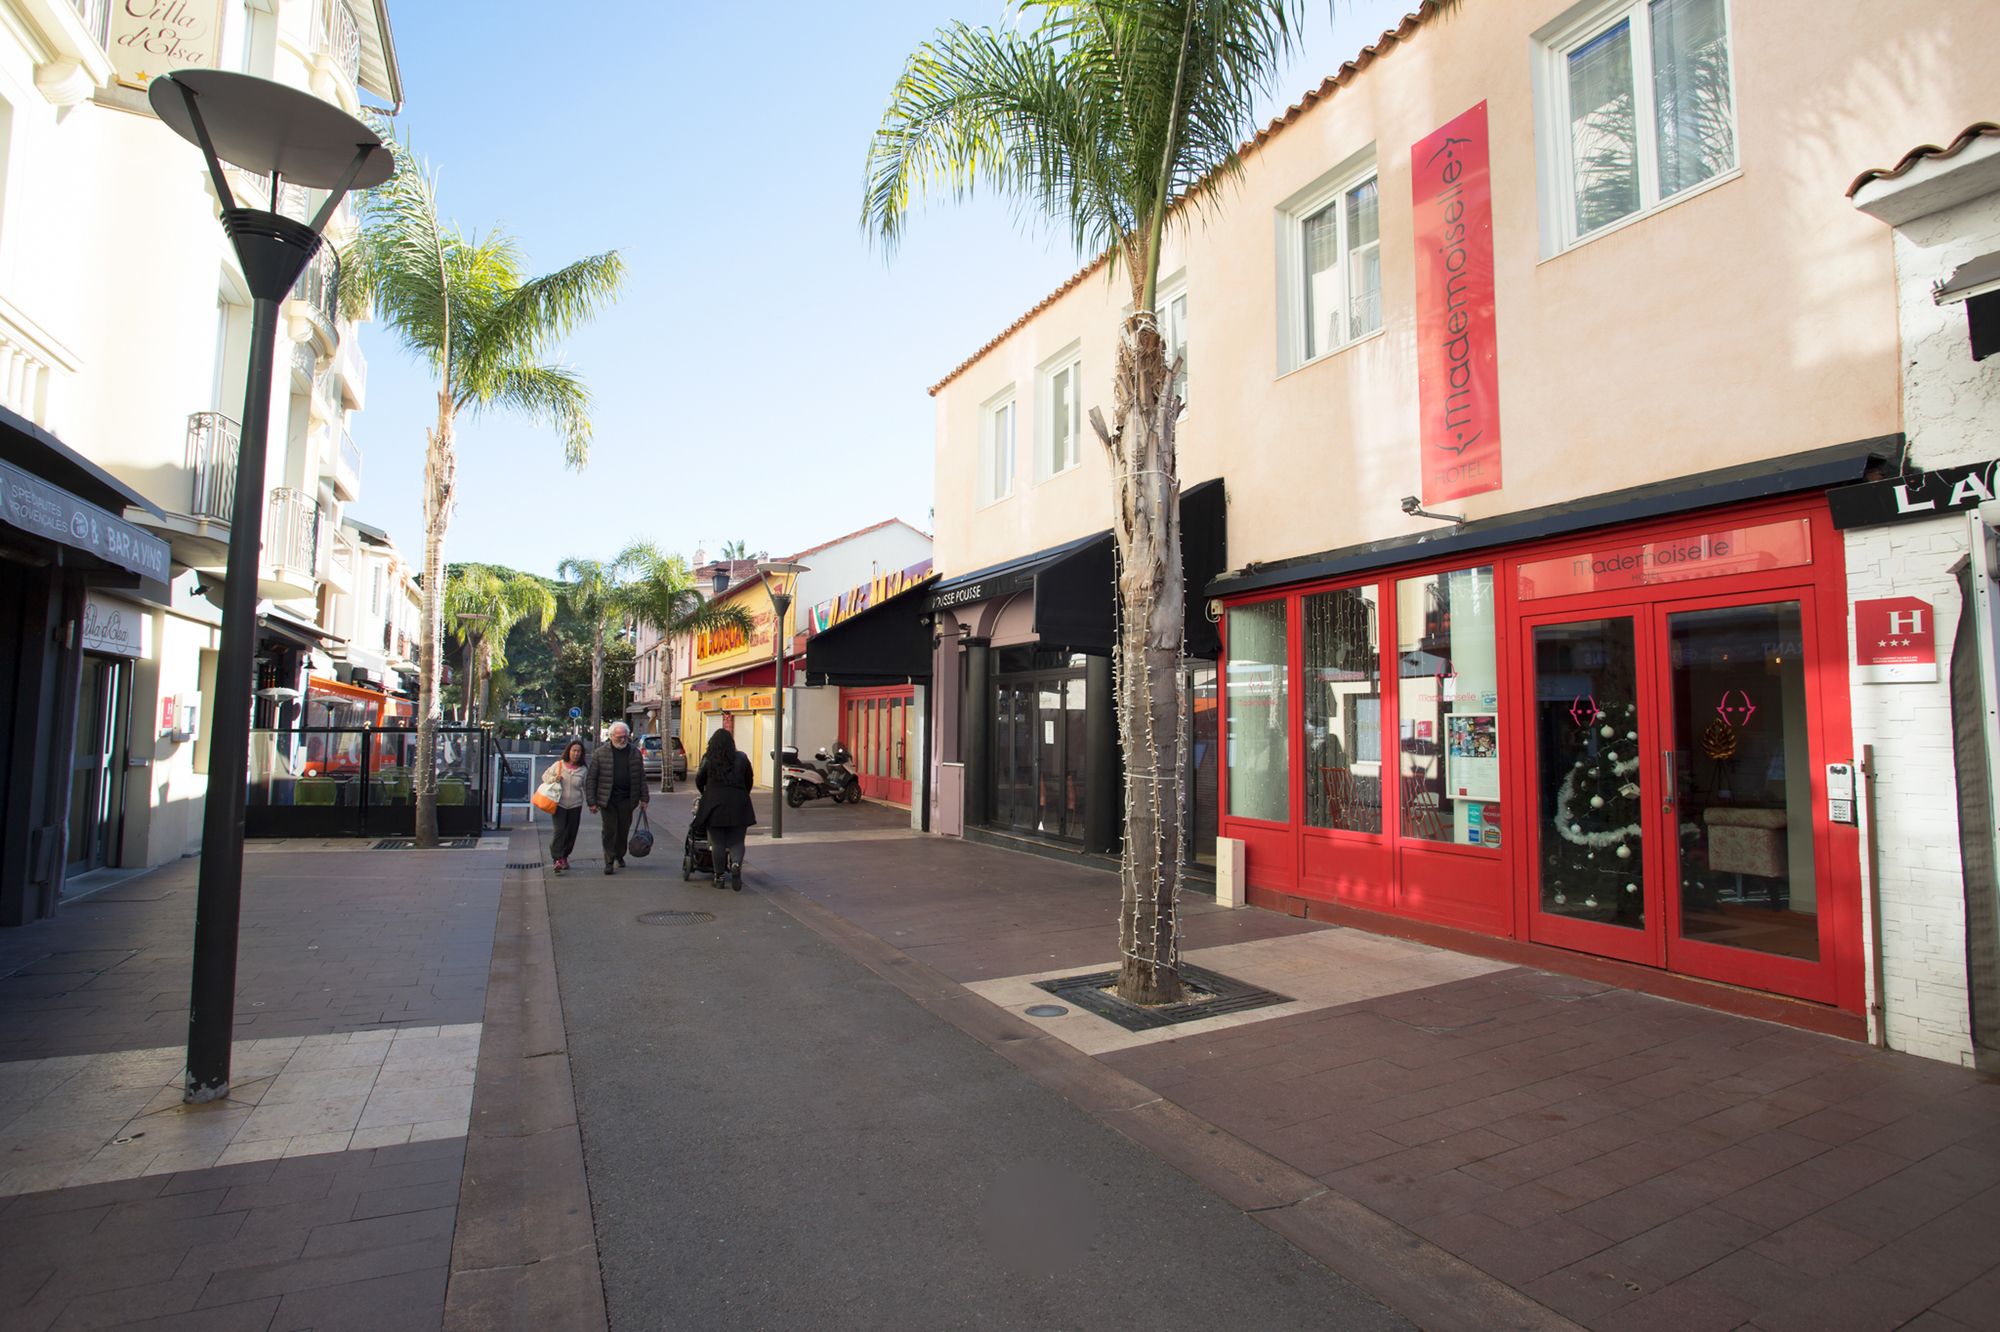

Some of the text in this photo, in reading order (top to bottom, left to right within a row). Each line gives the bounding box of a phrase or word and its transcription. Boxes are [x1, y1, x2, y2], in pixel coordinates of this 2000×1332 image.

[1435, 460, 1485, 483] HOTEL
[107, 526, 130, 558] BAR
[1573, 539, 1729, 577] mademoiselle
[1887, 609, 1925, 635] H
